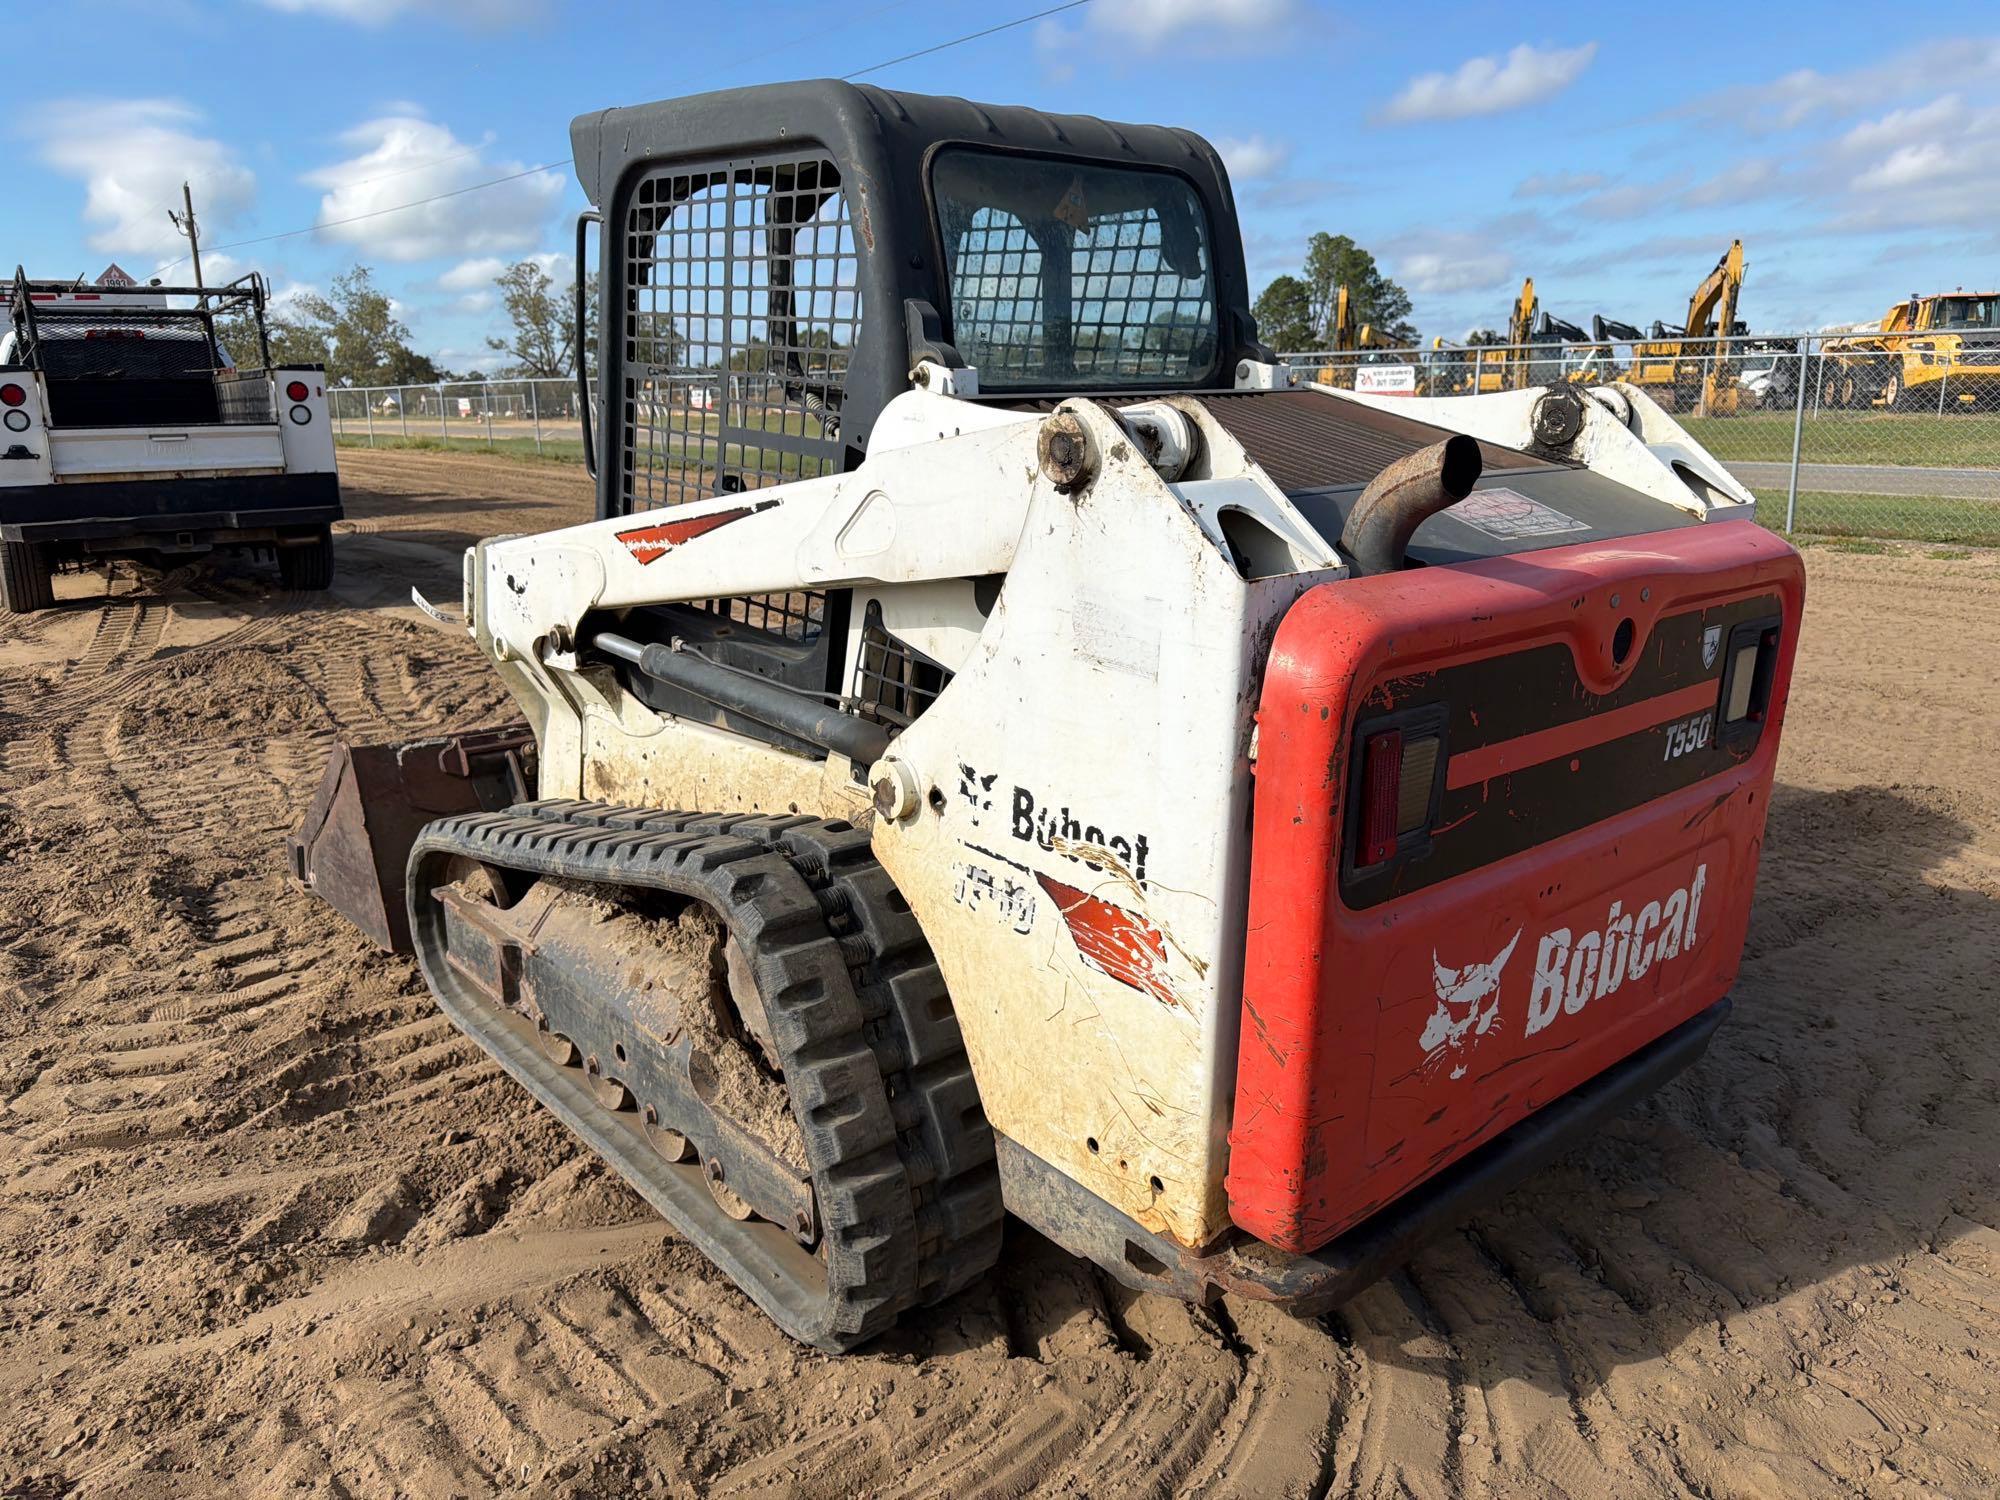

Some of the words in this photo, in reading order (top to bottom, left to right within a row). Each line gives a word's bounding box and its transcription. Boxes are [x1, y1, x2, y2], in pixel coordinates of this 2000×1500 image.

[106, 279, 126, 288] 1993
[1664, 713, 1712, 761] T550
[1525, 864, 1707, 1039] Bobcat
